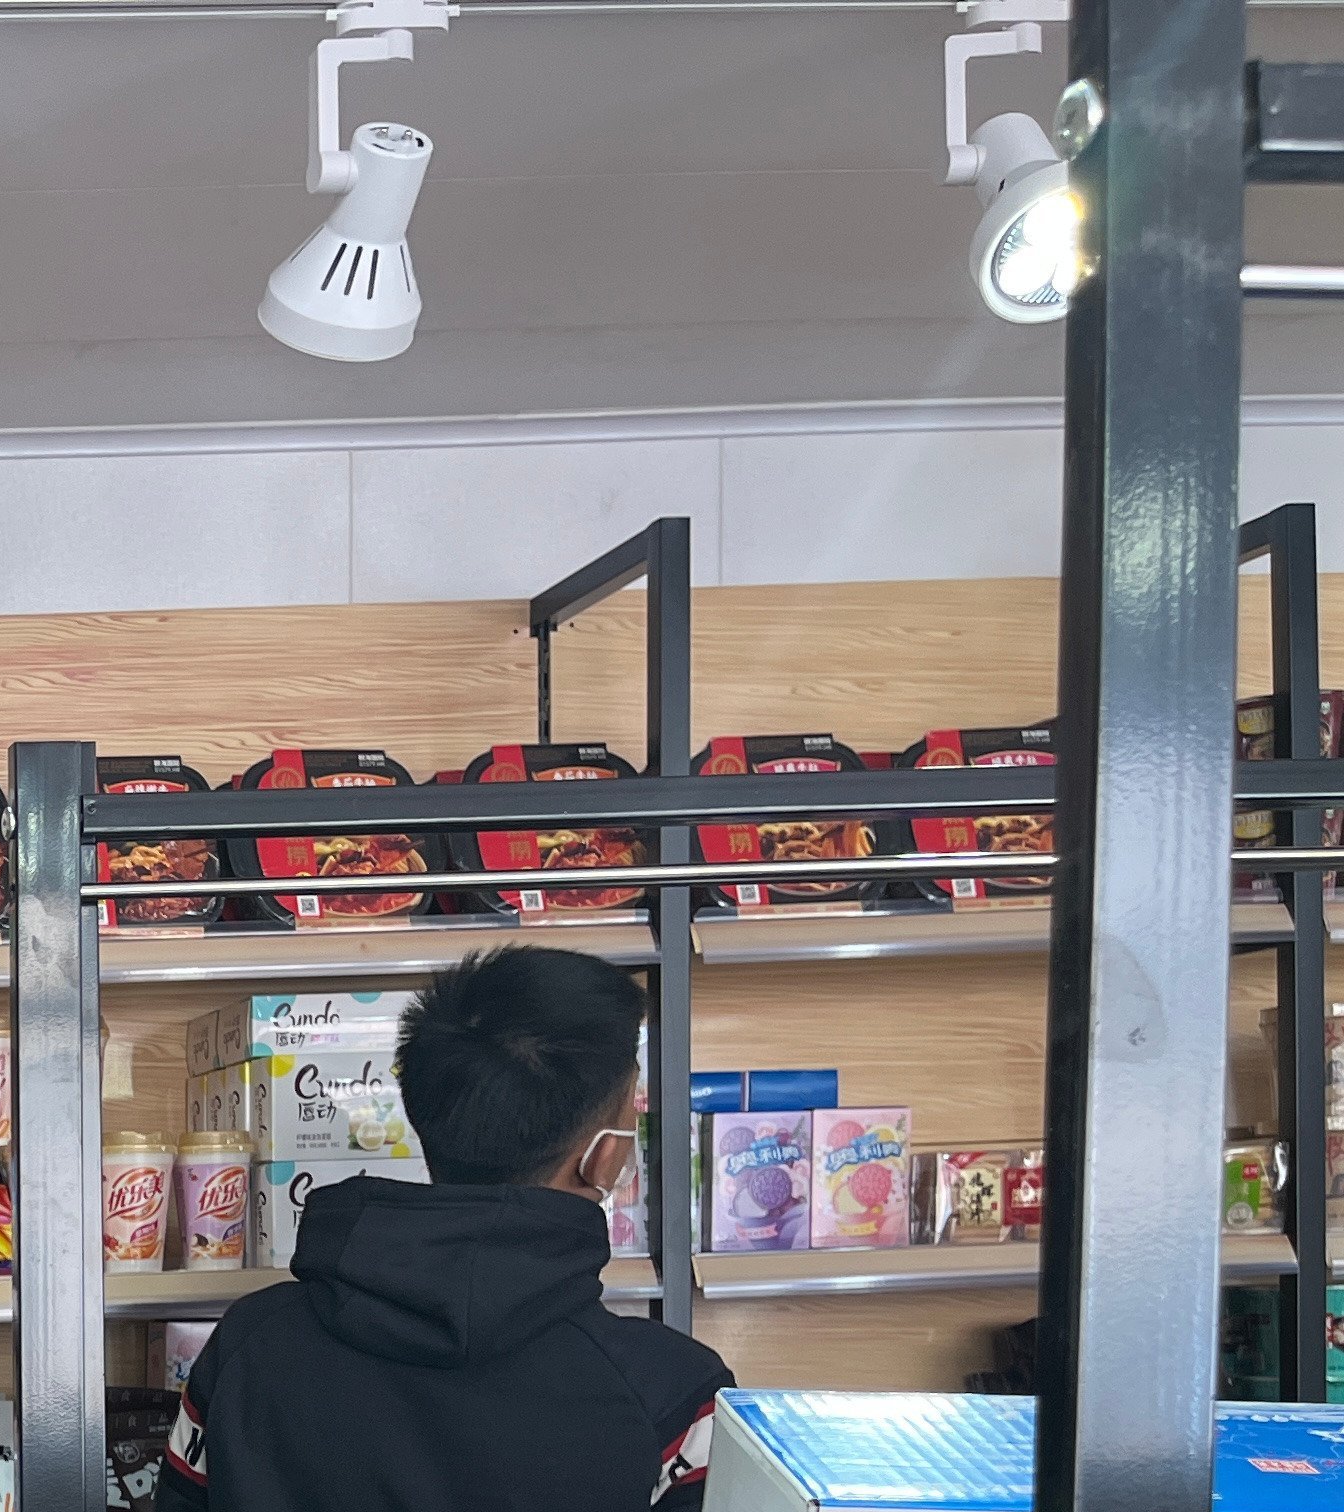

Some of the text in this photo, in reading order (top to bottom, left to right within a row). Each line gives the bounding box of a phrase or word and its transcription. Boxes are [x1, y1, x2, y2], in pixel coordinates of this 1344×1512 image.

[294, 1061, 383, 1101] Cundo
[107, 1172, 165, 1214] 优乐美
